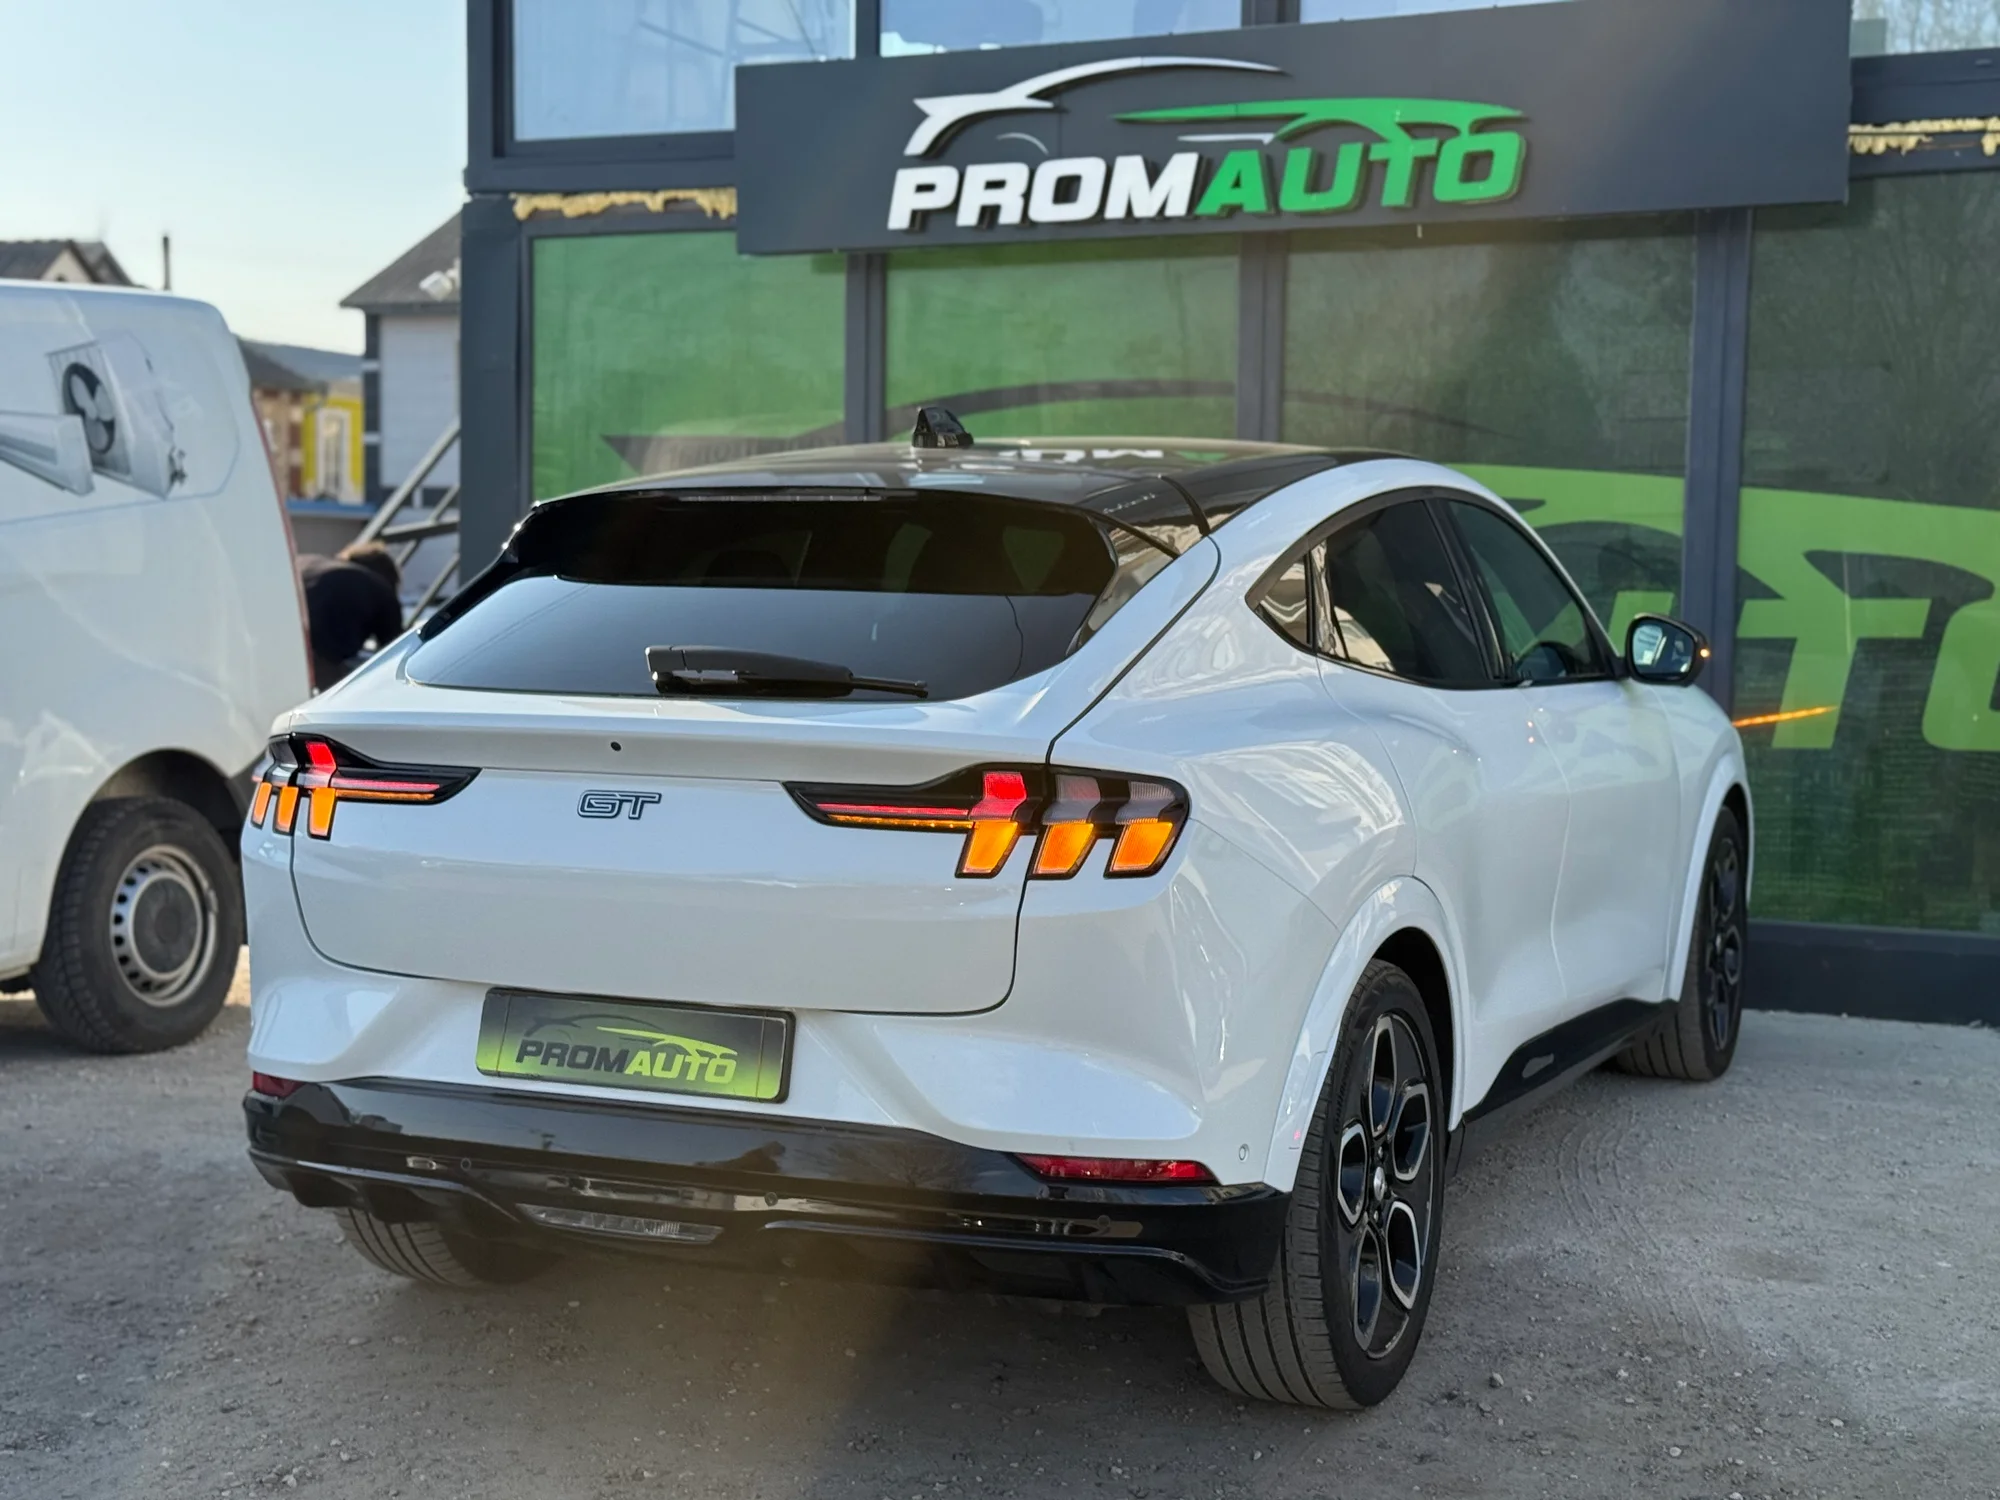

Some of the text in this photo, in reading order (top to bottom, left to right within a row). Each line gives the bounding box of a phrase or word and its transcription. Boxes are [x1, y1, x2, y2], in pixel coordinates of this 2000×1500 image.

[886, 131, 1526, 230] PROMAUTO
[577, 789, 662, 820] GT
[515, 1040, 738, 1086] PROMAUTO
